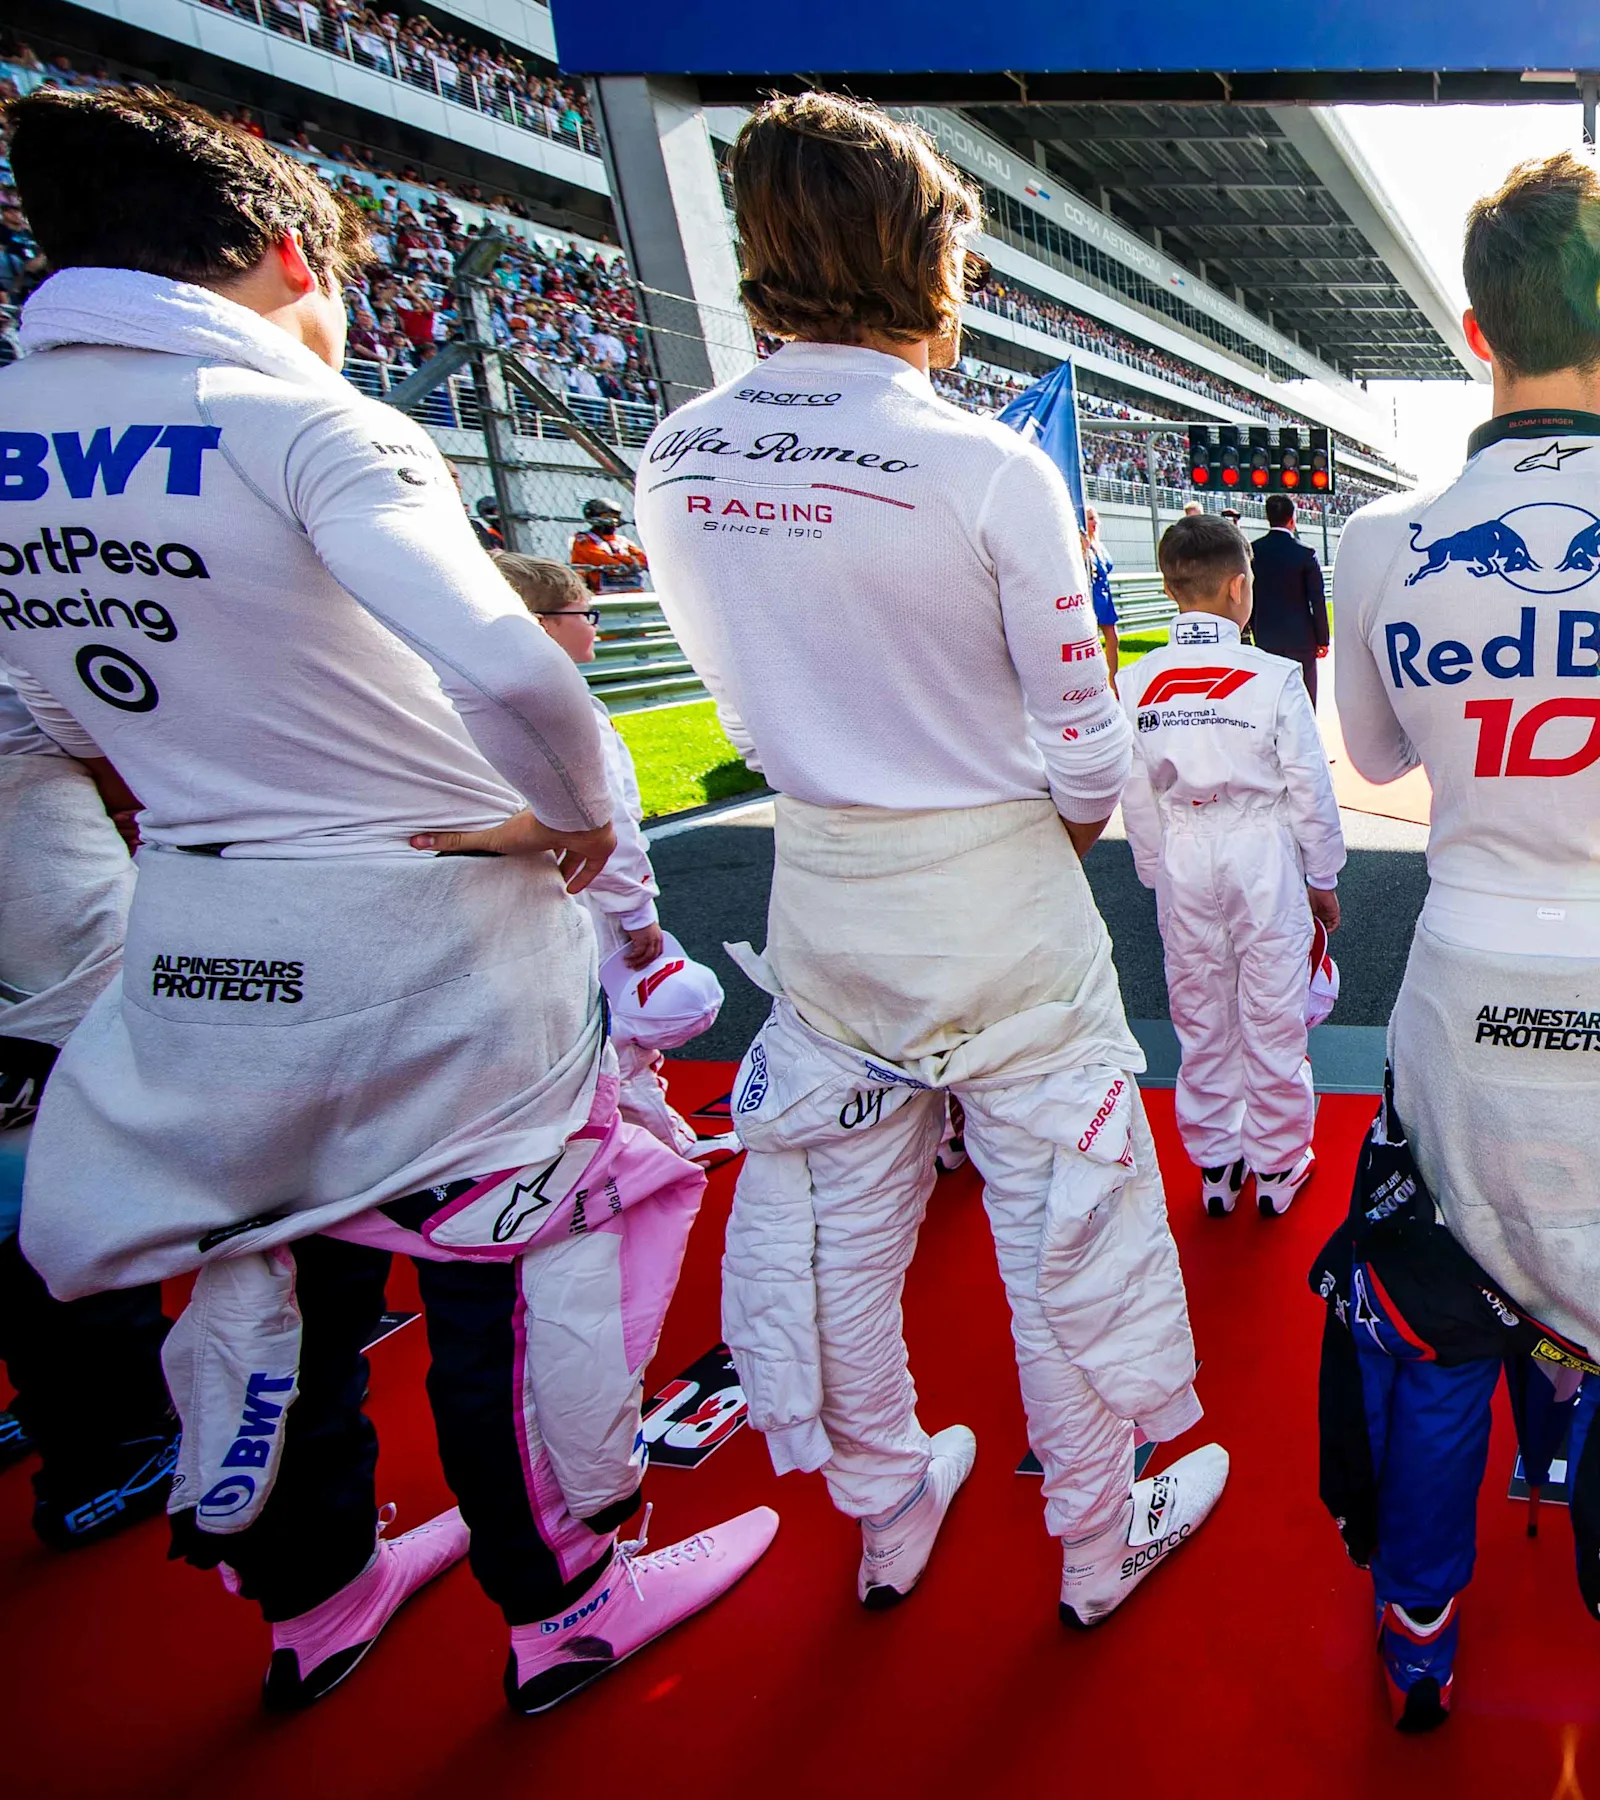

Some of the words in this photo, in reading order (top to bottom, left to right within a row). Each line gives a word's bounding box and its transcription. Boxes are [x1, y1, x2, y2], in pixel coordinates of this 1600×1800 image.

[910, 107, 1011, 180] ODROM.RU
[1064, 202, 1101, 238] СОЧИ
[1103, 229, 1161, 276] АВТОДРОМ
[736, 388, 842, 406] sparco
[0, 425, 223, 501] BWT
[649, 426, 740, 473] Alfa
[745, 432, 919, 473] Romeo
[686, 496, 833, 524] RACING
[703, 521, 770, 536] SINCE
[787, 528, 823, 539] 1910
[0, 588, 178, 643] Racing
[1385, 606, 1537, 690] Red
[1138, 715, 1160, 733] FIA
[1162, 711, 1176, 719] FIA
[1162, 719, 1189, 727] World
[152, 955, 304, 979] ALPINESTARS
[152, 973, 304, 1004] PROTECTS
[738, 1044, 768, 1113] sparco
[1077, 1080, 1125, 1152] CARRERA
[221, 1373, 295, 1468] BWT
[642, 1379, 749, 1449] 18
[1120, 1523, 1191, 1580] sparco
[563, 1588, 611, 1630] BWT
